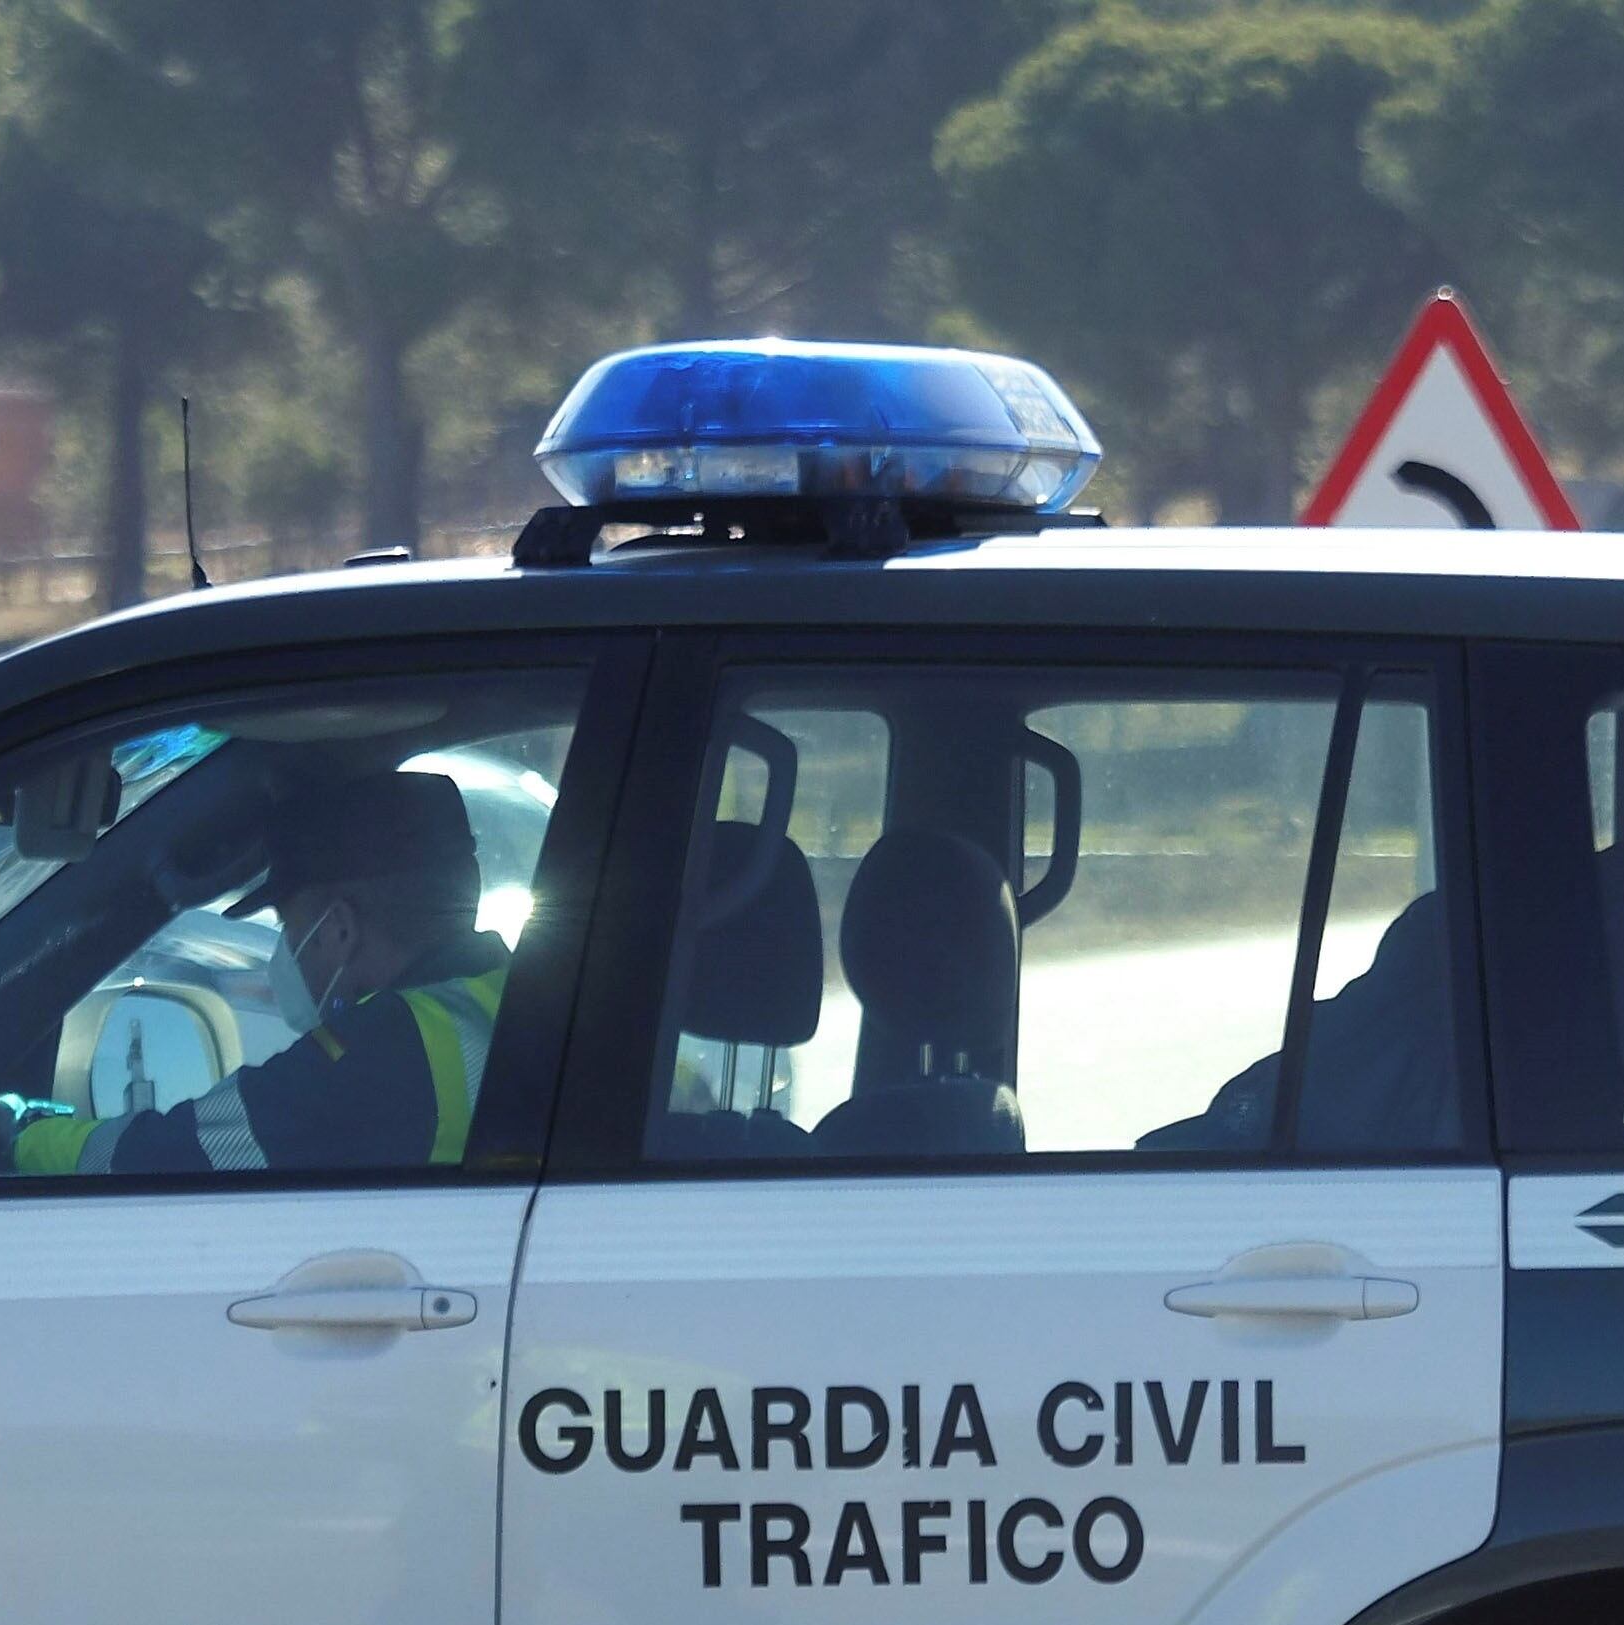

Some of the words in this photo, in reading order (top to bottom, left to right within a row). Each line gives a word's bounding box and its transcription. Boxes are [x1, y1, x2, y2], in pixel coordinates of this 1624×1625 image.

[517, 1383, 998, 1475] GUARDIA
[1037, 1380, 1307, 1467] CIVIL
[679, 1496, 1146, 1588] TRAFICO
